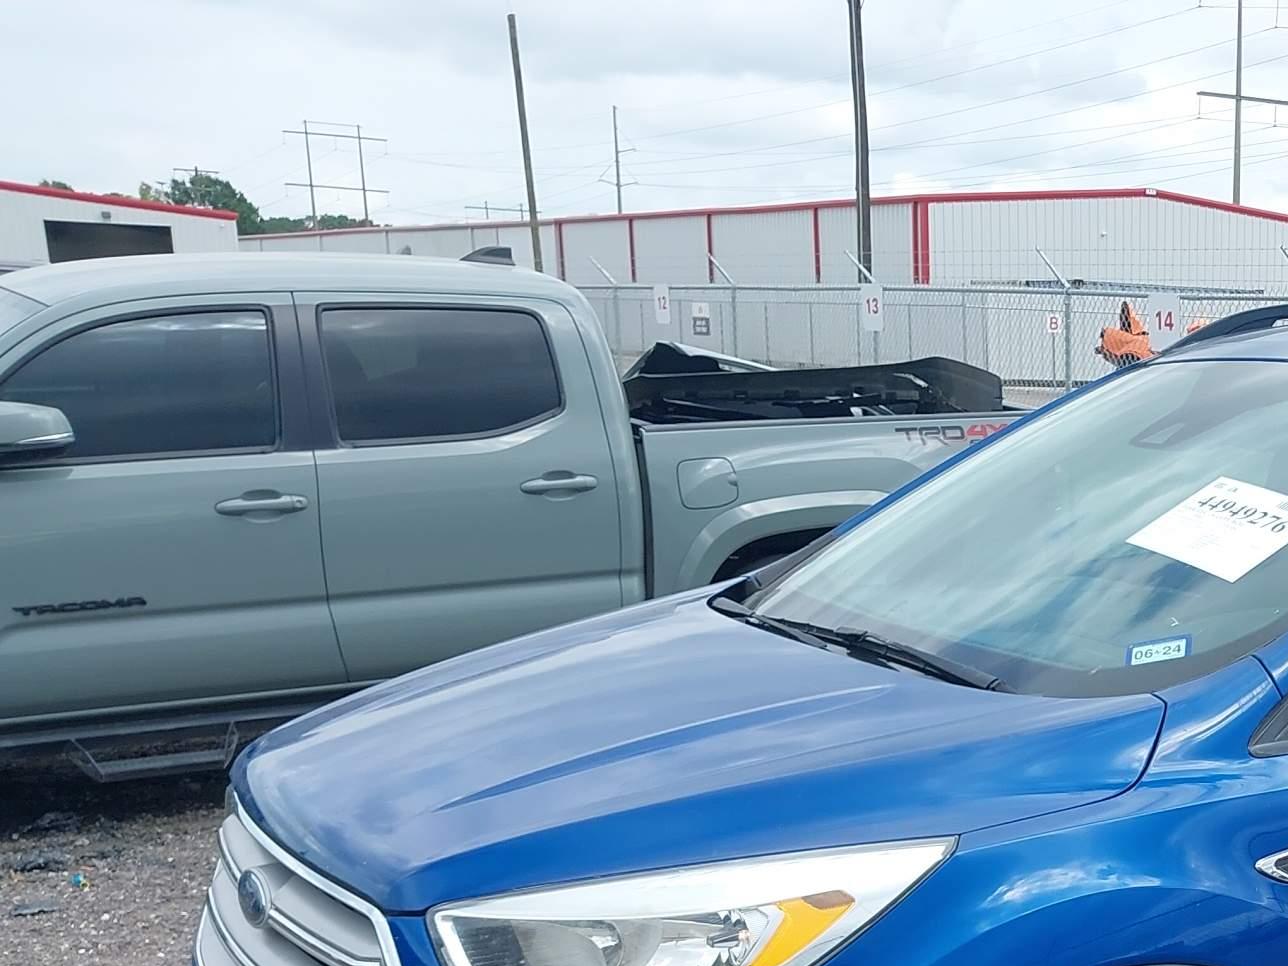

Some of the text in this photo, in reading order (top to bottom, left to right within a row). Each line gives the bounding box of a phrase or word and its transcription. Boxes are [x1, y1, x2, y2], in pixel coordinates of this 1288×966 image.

[657, 295, 668, 311] 12
[866, 297, 879, 315] 13
[1049, 316, 1059, 331] B
[1155, 310, 1174, 331] 14
